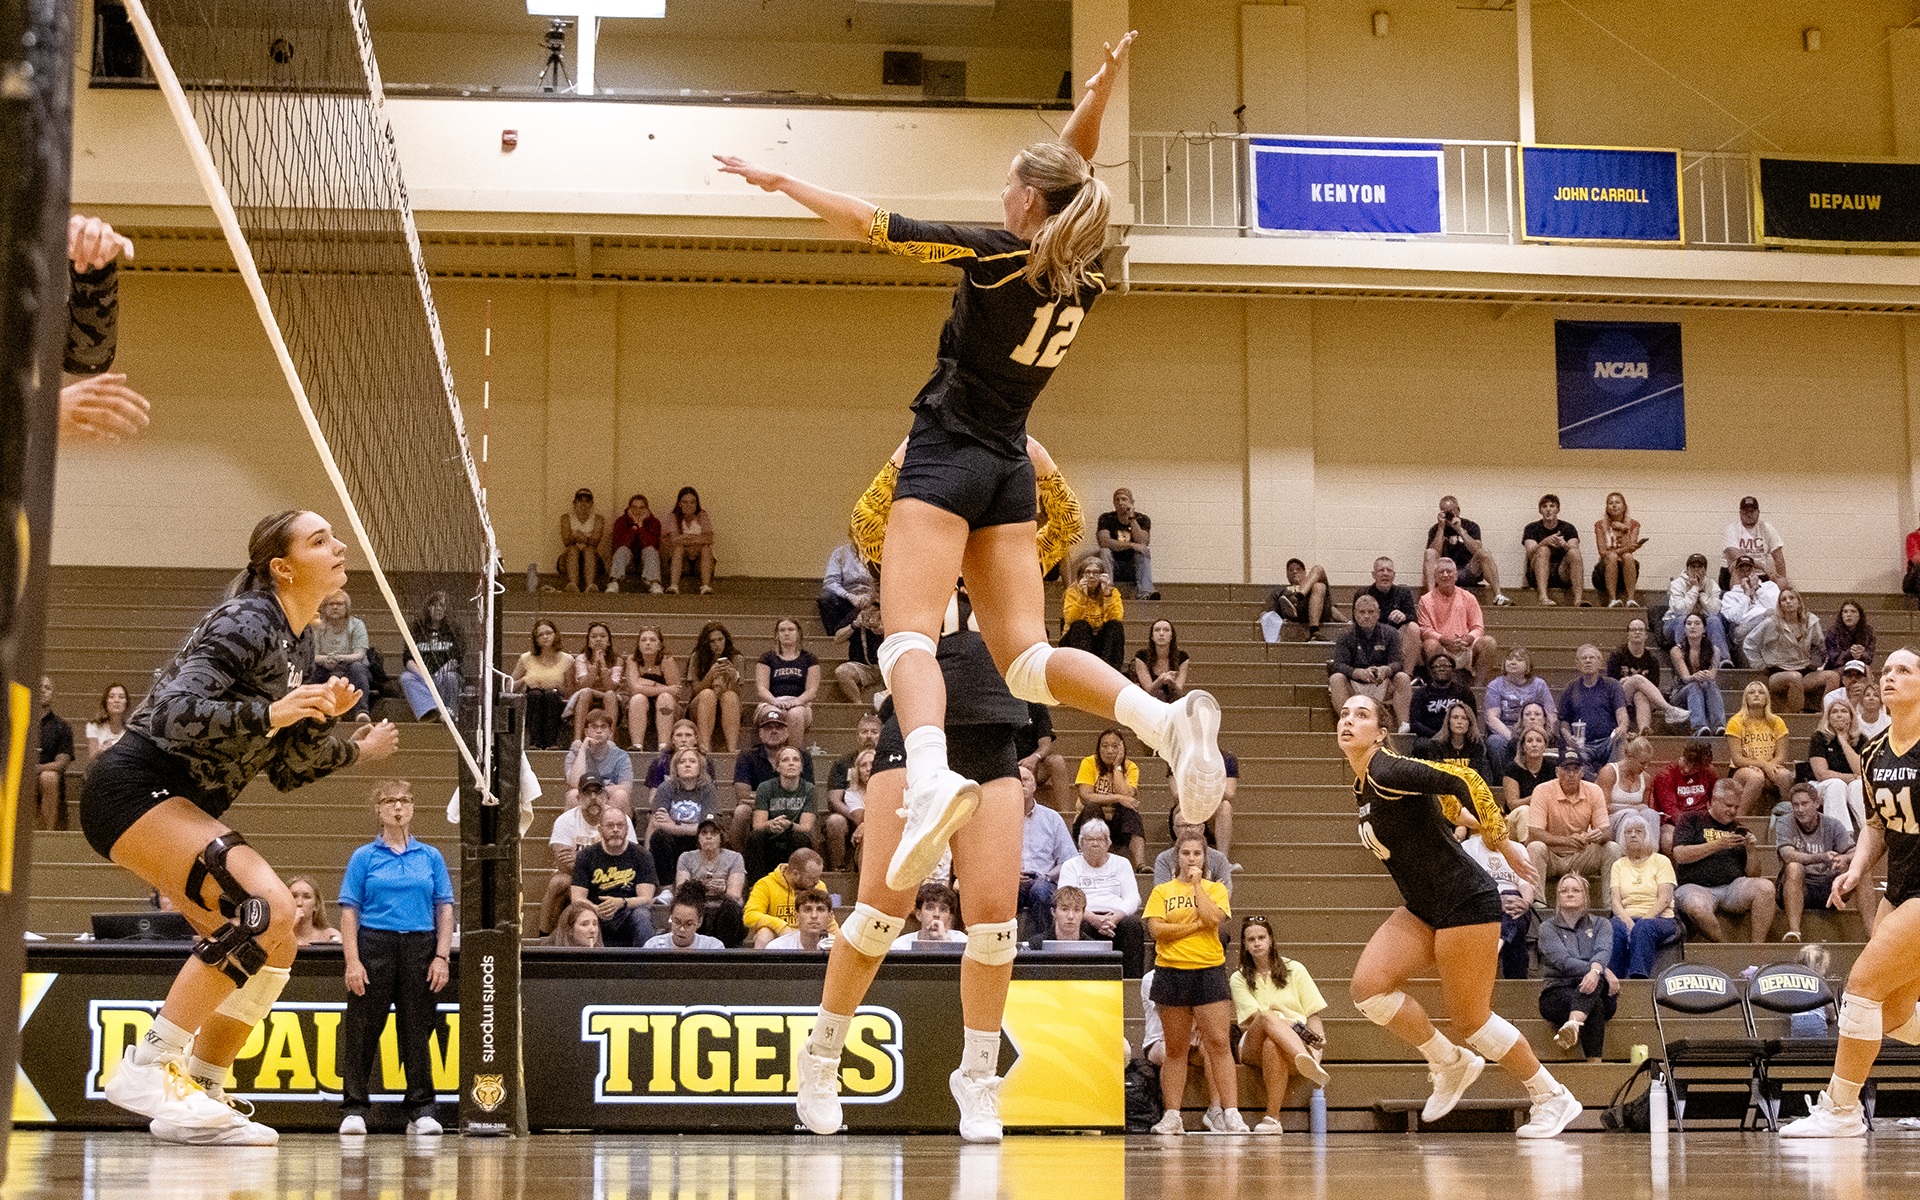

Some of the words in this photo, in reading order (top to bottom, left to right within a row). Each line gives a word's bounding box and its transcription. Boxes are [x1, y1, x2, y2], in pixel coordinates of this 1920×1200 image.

[1311, 183, 1386, 203] KENYON
[1553, 187, 1589, 201] JOHN
[1591, 187, 1649, 203] CARROLL
[1809, 193, 1881, 210] DEPAUW
[1009, 302, 1085, 368] 12
[1594, 361, 1648, 379] NCAA
[1875, 786, 1920, 834] 21
[480, 955, 495, 1002] sports
[1667, 975, 1724, 993] DEPAUW
[1760, 975, 1816, 992] DEPAUW
[480, 1004, 495, 1062] imports
